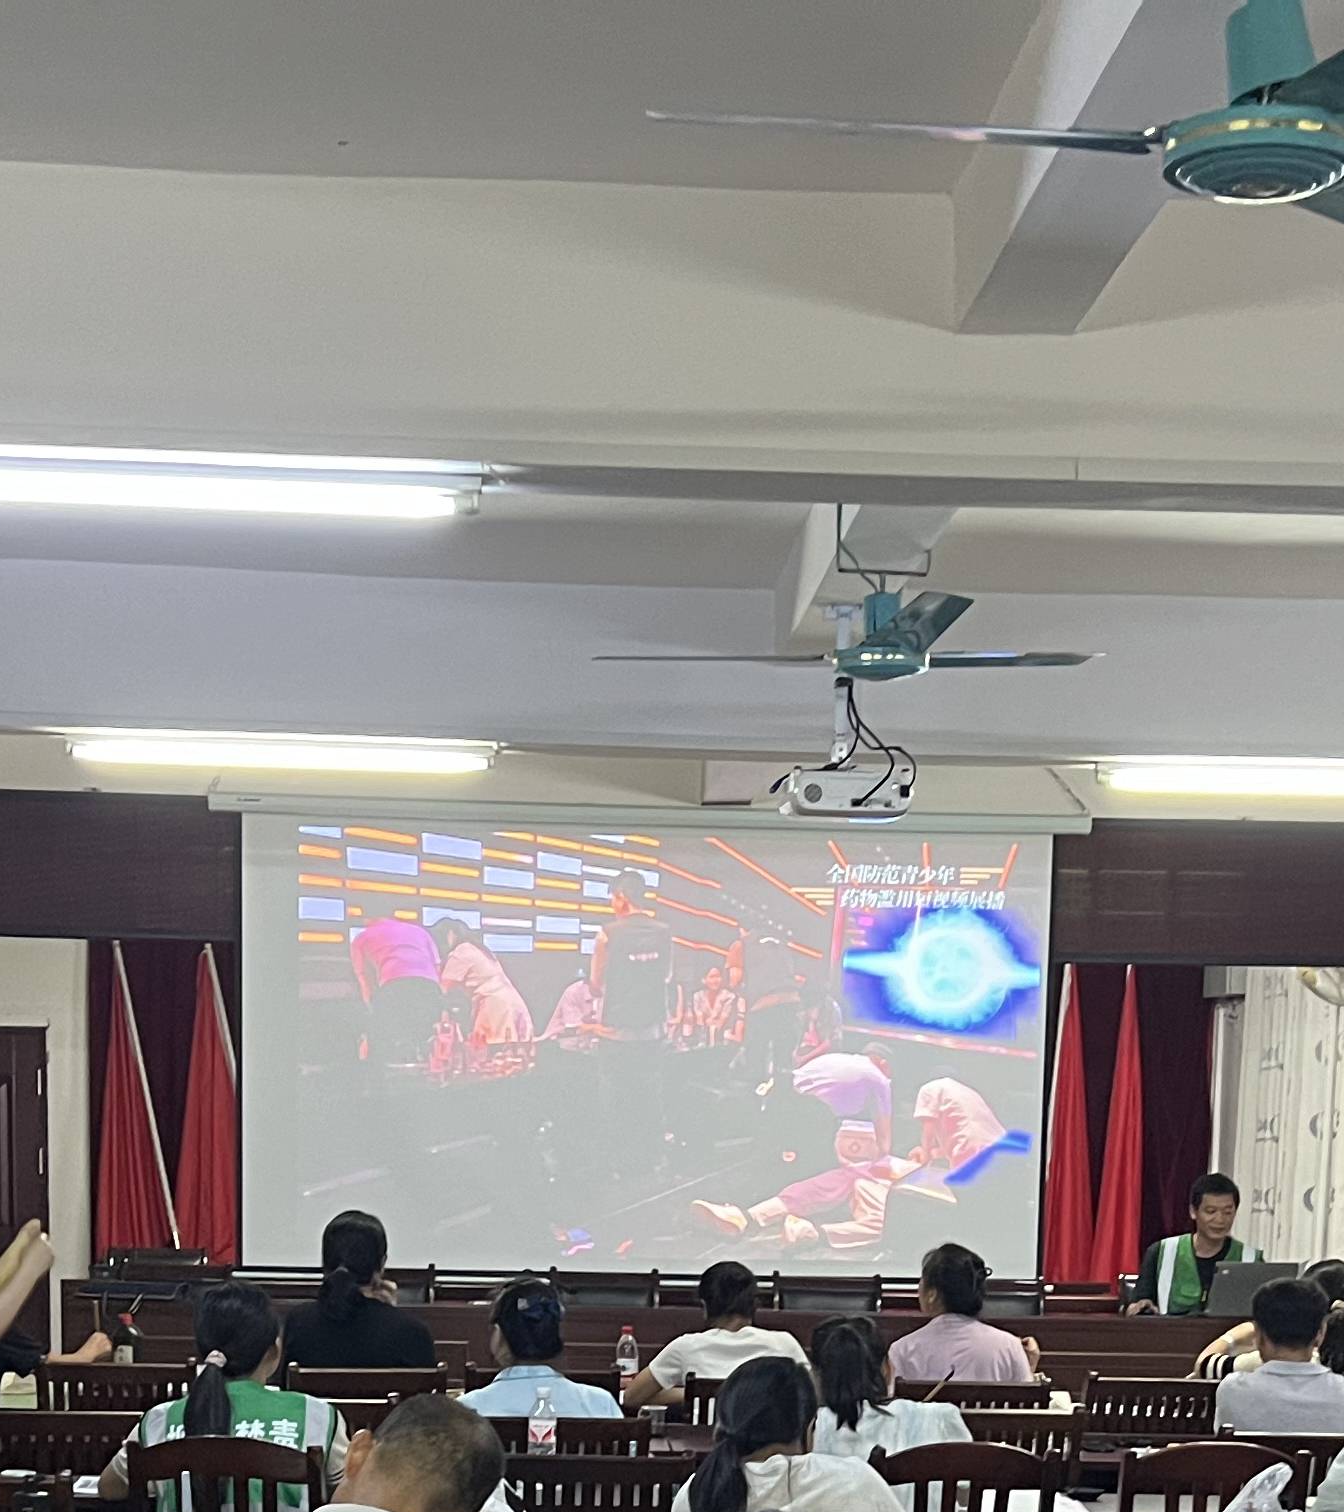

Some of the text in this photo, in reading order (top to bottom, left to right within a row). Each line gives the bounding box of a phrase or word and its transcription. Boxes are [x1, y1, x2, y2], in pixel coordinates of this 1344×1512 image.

[826, 864, 955, 884] 全国防范青少年
